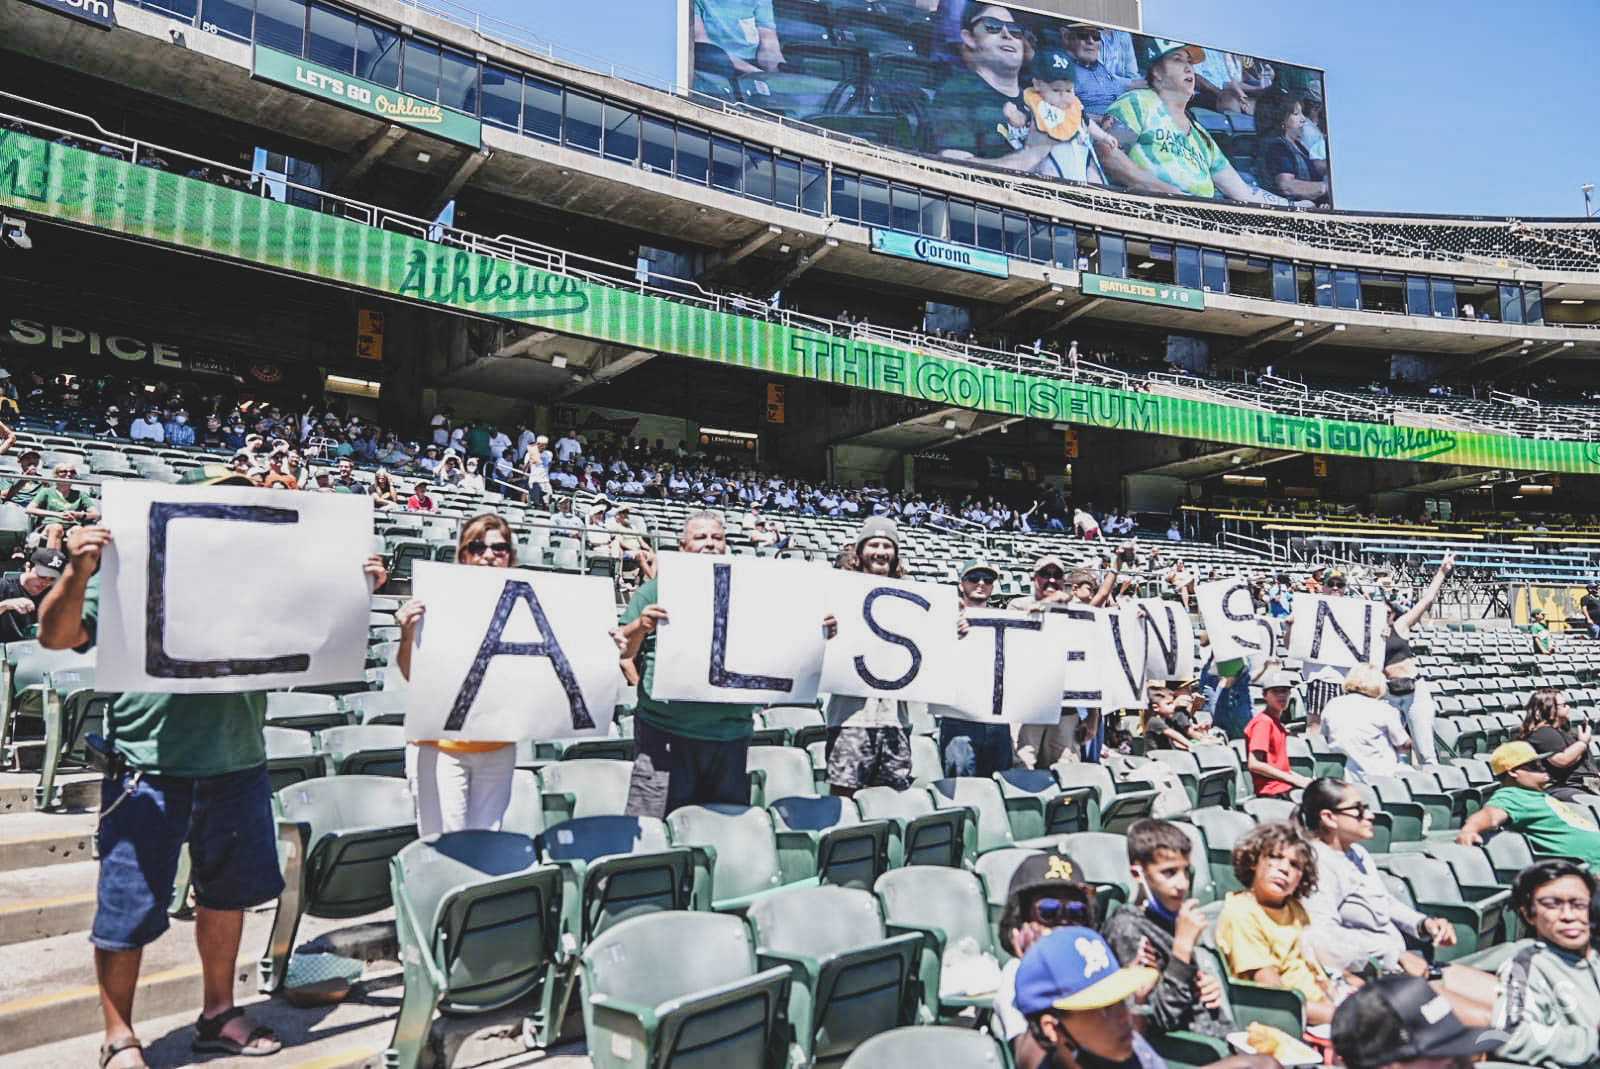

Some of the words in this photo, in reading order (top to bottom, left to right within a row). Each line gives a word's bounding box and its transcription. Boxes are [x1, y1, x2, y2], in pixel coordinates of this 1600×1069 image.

[57, 0, 109, 17] om
[296, 66, 344, 95] LET'S
[347, 84, 371, 105] GO
[375, 94, 443, 124] Oakland
[914, 239, 971, 265] Corona
[400, 249, 589, 319] Athletics
[1099, 279, 1156, 297] @ATHLETICS
[8, 318, 183, 369] SPICE
[791, 335, 905, 397] THE
[915, 361, 1160, 434] COLISEUM
[1256, 414, 1322, 449] LET'S
[1327, 423, 1361, 451] GO
